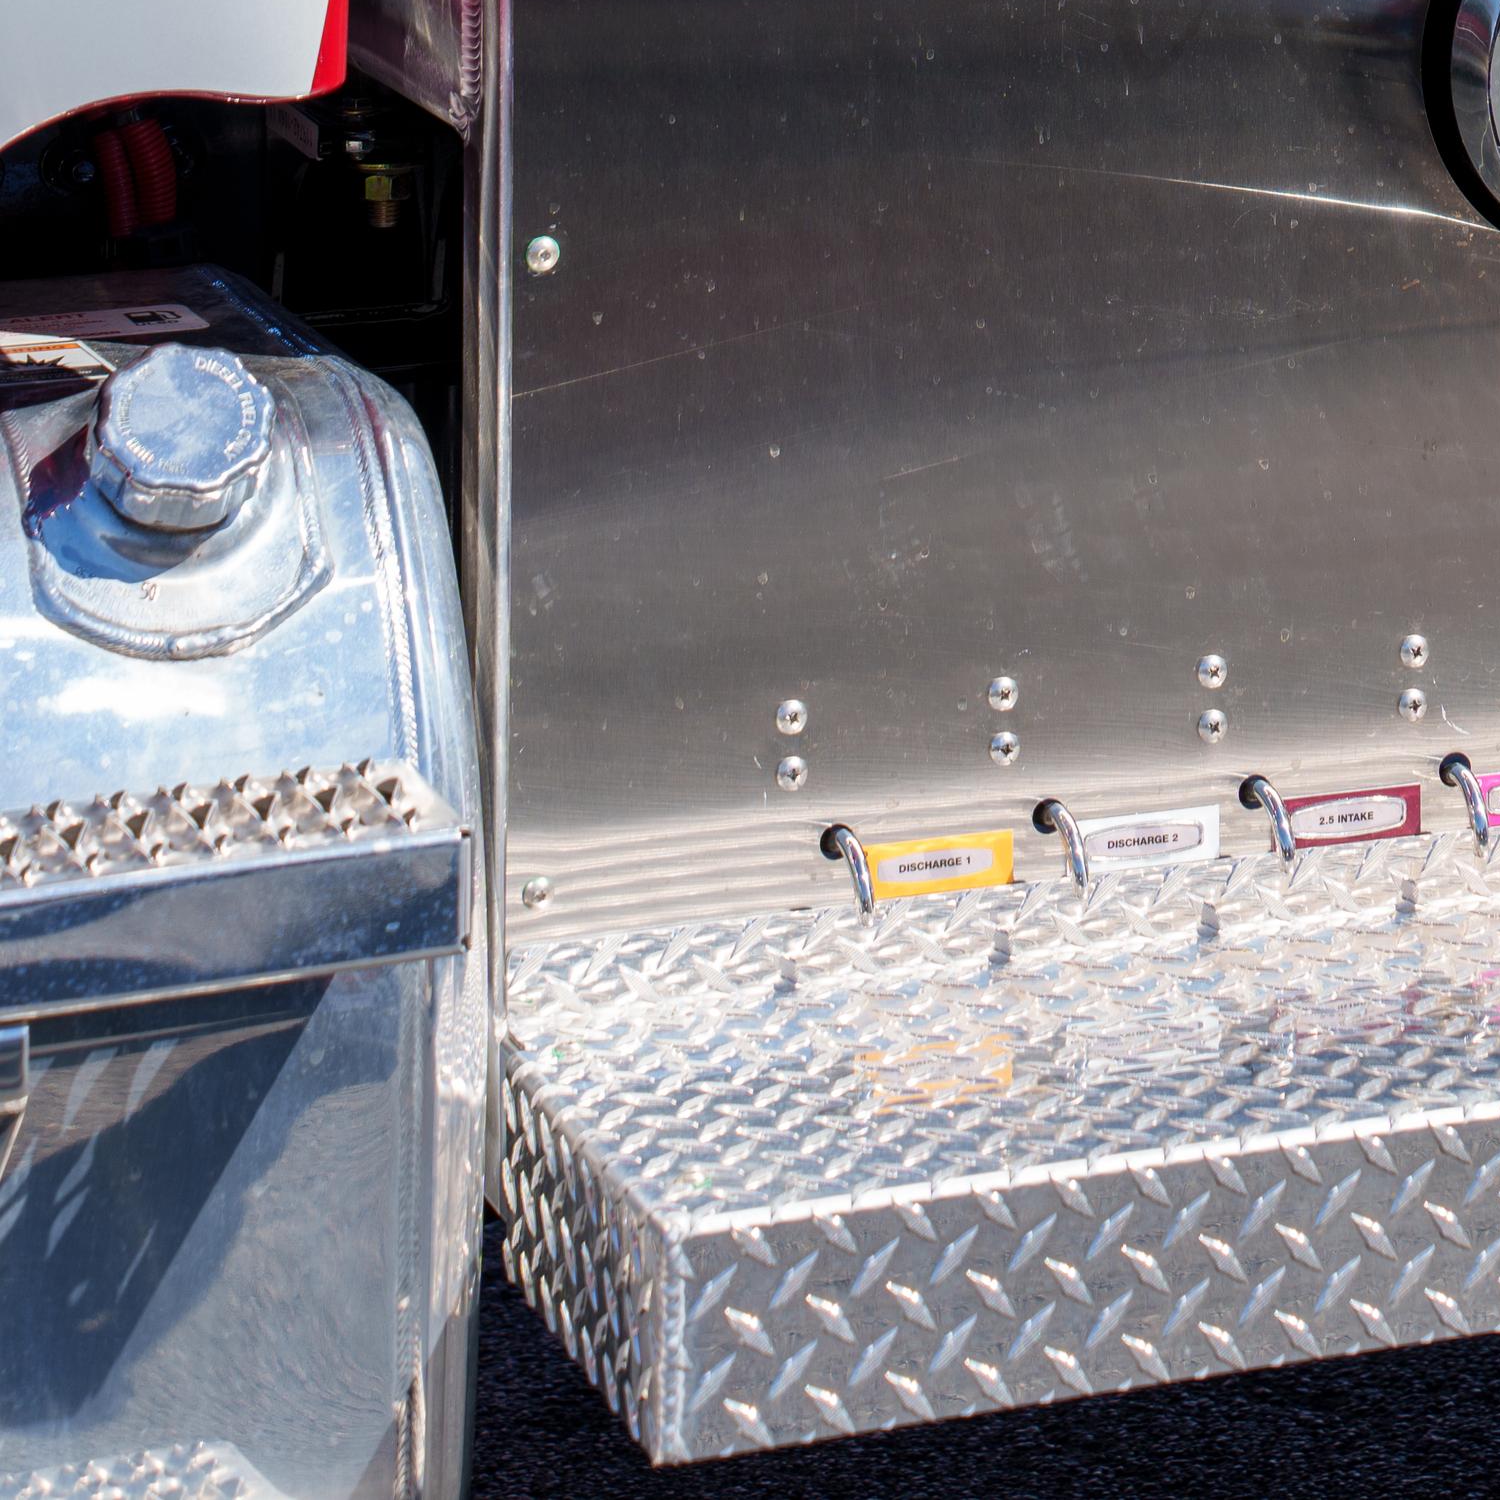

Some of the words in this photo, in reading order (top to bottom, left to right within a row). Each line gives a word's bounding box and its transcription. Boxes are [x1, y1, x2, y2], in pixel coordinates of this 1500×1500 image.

[195, 356, 243, 389] DIESEL
[238, 392, 256, 426] FUEL
[1320, 816, 1334, 825] 2.5
[1338, 811, 1374, 823] INTAKE
[1107, 834, 1169, 849] DISCHARGE
[1173, 833, 1179, 842] 2
[899, 859, 962, 873] DISCHARGE
[967, 857, 971, 865] 1
